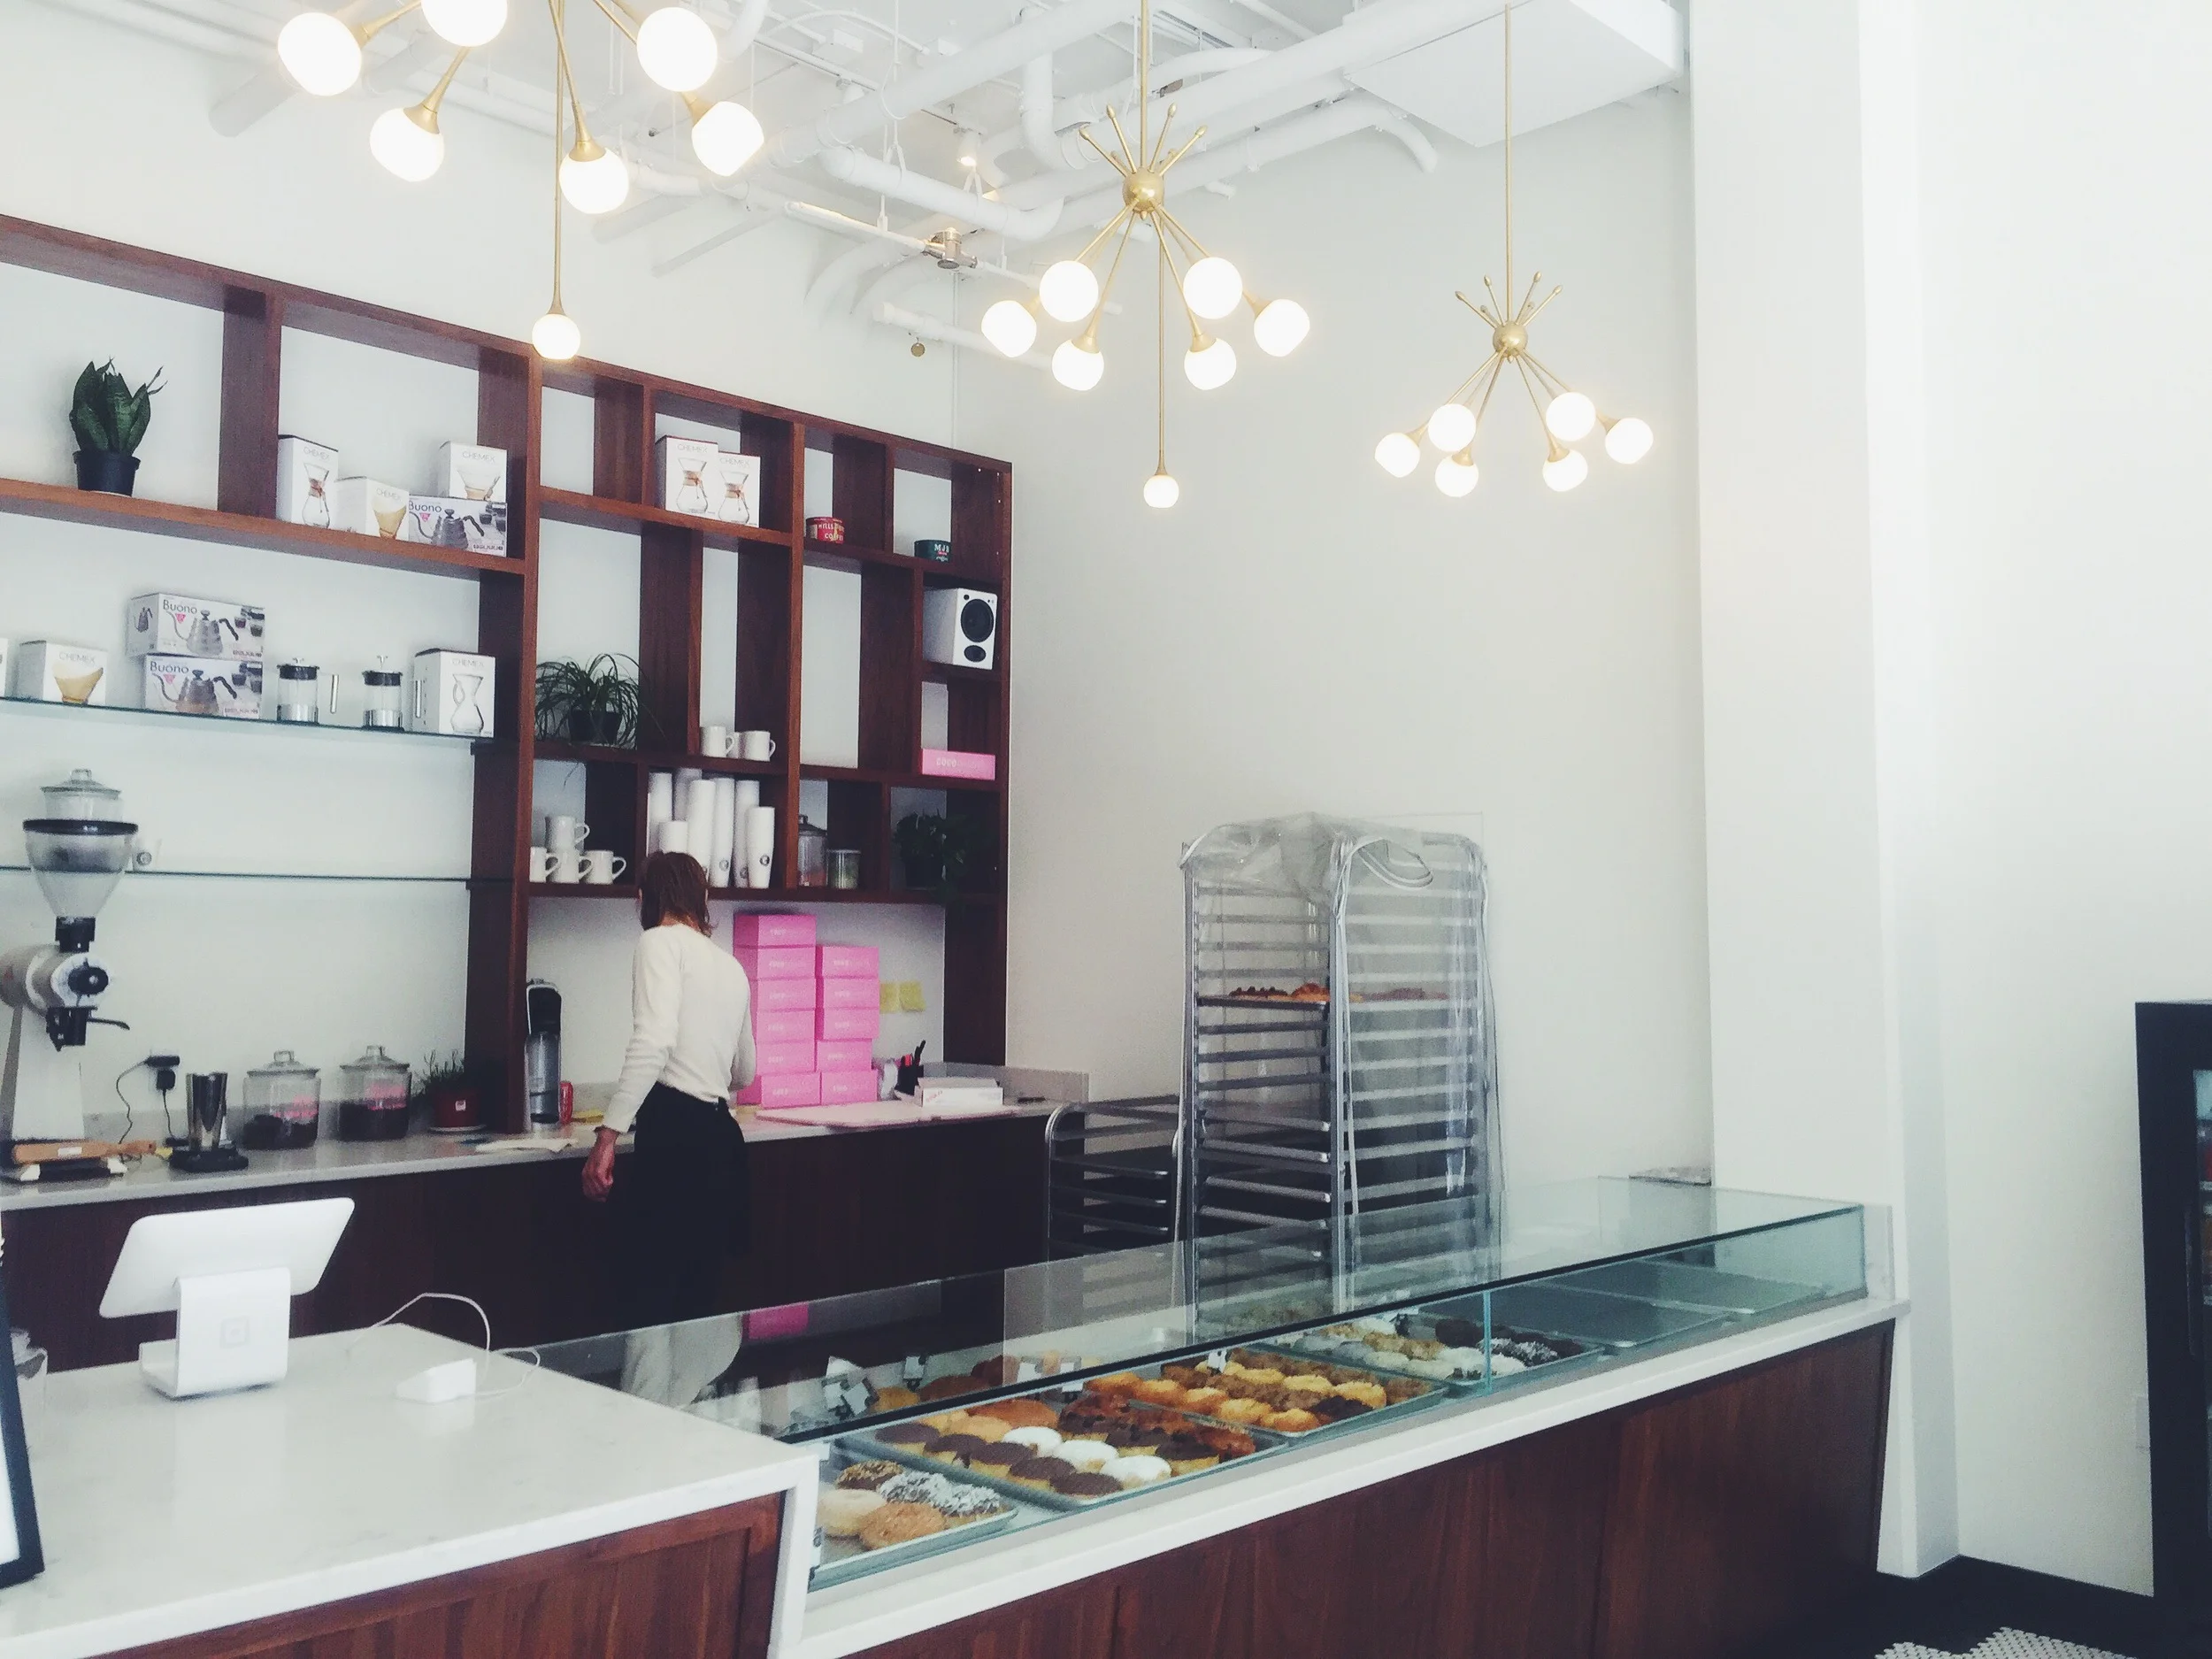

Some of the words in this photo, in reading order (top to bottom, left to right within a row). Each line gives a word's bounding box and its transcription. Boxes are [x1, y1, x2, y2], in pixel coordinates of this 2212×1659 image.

[462, 450, 495, 463] CHEMEX
[409, 500, 442, 512] Buono
[163, 599, 197, 614] Buono
[150, 660, 189, 673] Buono
